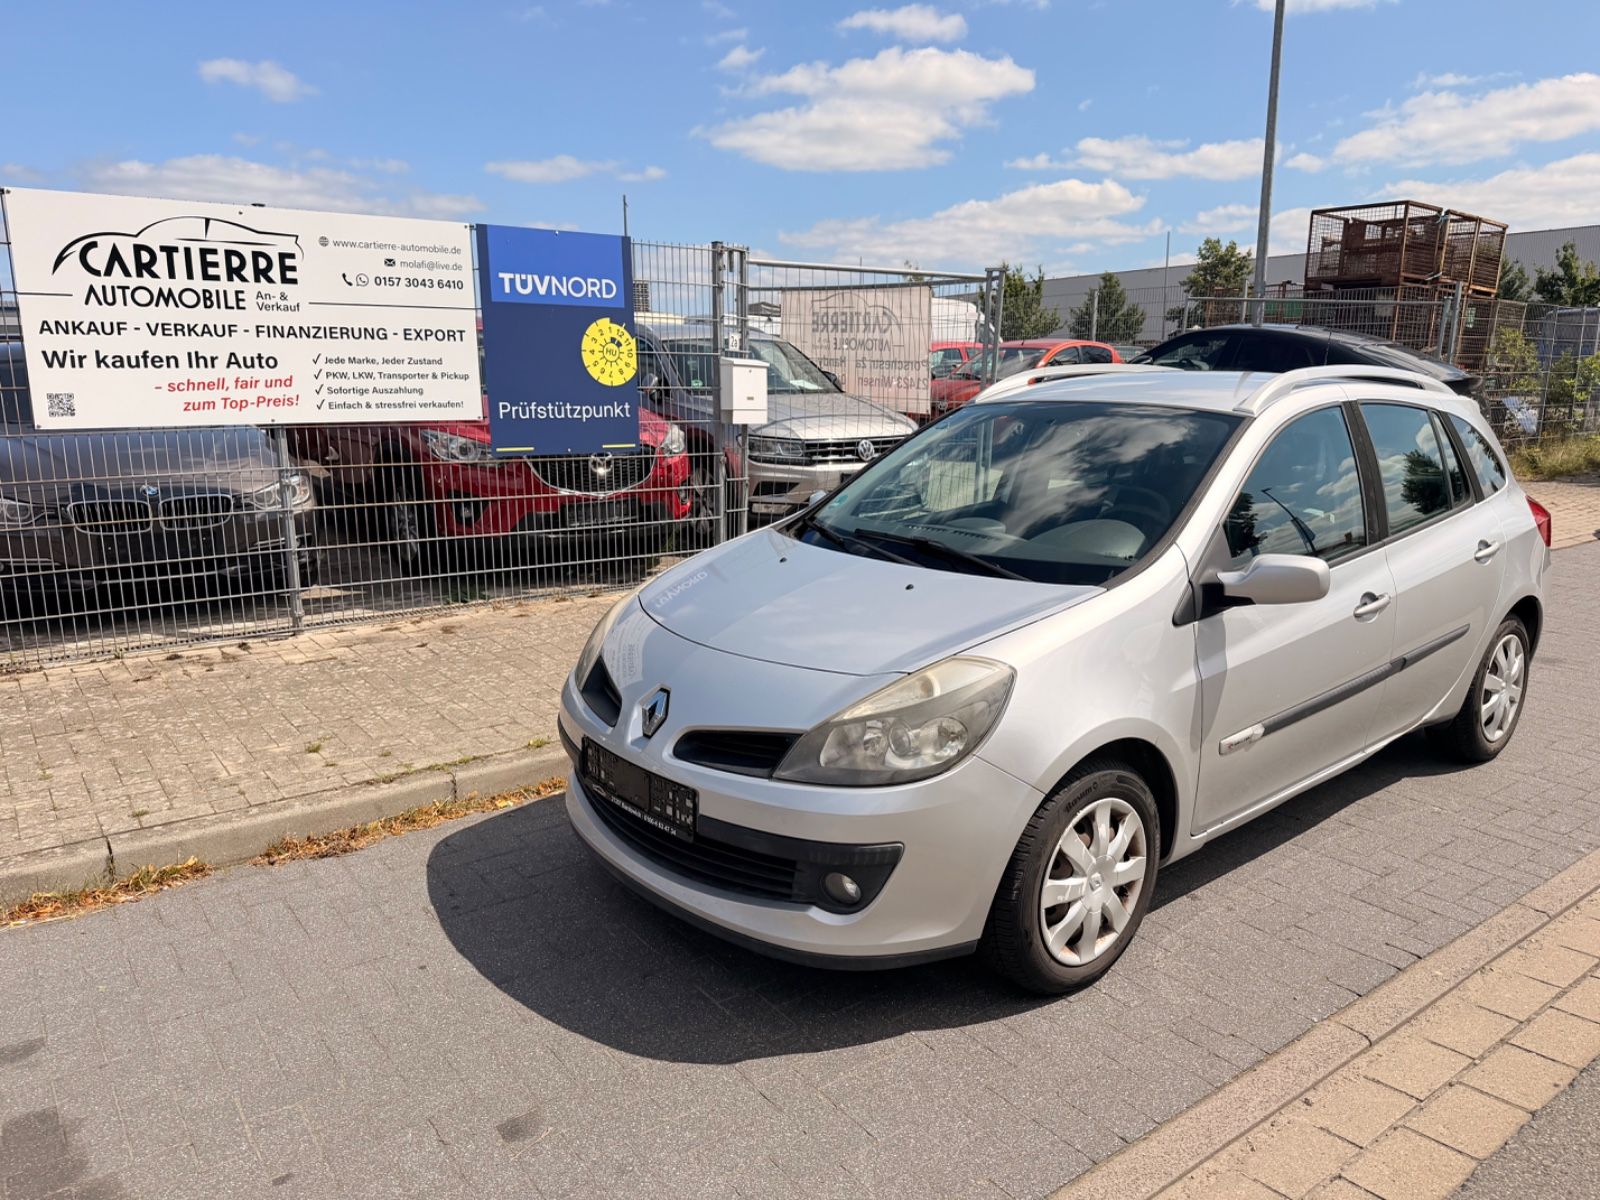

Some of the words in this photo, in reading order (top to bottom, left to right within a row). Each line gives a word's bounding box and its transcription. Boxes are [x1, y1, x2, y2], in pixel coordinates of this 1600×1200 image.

[332, 239, 462, 254] www.cartierre-automobile.de
[79, 240, 298, 285] CARTIERRE
[400, 260, 462, 271] molafi@live.de
[374, 276, 401, 287] 0157
[404, 278, 434, 288] 3043
[438, 279, 464, 290] 6410
[84, 284, 246, 310] AUTOMOBILE
[256, 291, 276, 300] An-
[279, 292, 288, 300] &
[258, 302, 300, 312] Verkauf
[39, 320, 128, 336] ANKAUF
[146, 322, 238, 338] VERKAUF
[255, 325, 388, 340] FINANZIERUNG
[403, 328, 466, 342] EXPORT
[606, 348, 617, 356] HU
[42, 350, 87, 369] Wir
[94, 350, 179, 369] kaufen
[187, 351, 218, 369] Ihr
[226, 352, 278, 370] Auto
[324, 356, 346, 364] Jede
[348, 357, 379, 366] Marke,
[382, 357, 405, 365] Jeder
[407, 357, 443, 366] Zustand
[167, 377, 230, 392] schnell,
[234, 376, 260, 390] fair
[264, 375, 293, 388] und
[326, 371, 350, 380] PKW,
[352, 372, 376, 380] LKW,
[378, 372, 429, 381] Transporter
[440, 372, 470, 382] Pickup
[326, 386, 370, 396] Sofortige
[372, 386, 424, 396] Auszahlung
[183, 400, 216, 412] zum
[221, 394, 300, 412] Top-Preis!
[328, 402, 362, 410] Einfach
[375, 401, 416, 409] stressfrei
[418, 400, 464, 409] verkaufen!
[498, 401, 631, 422] Prüfstützpunkt
